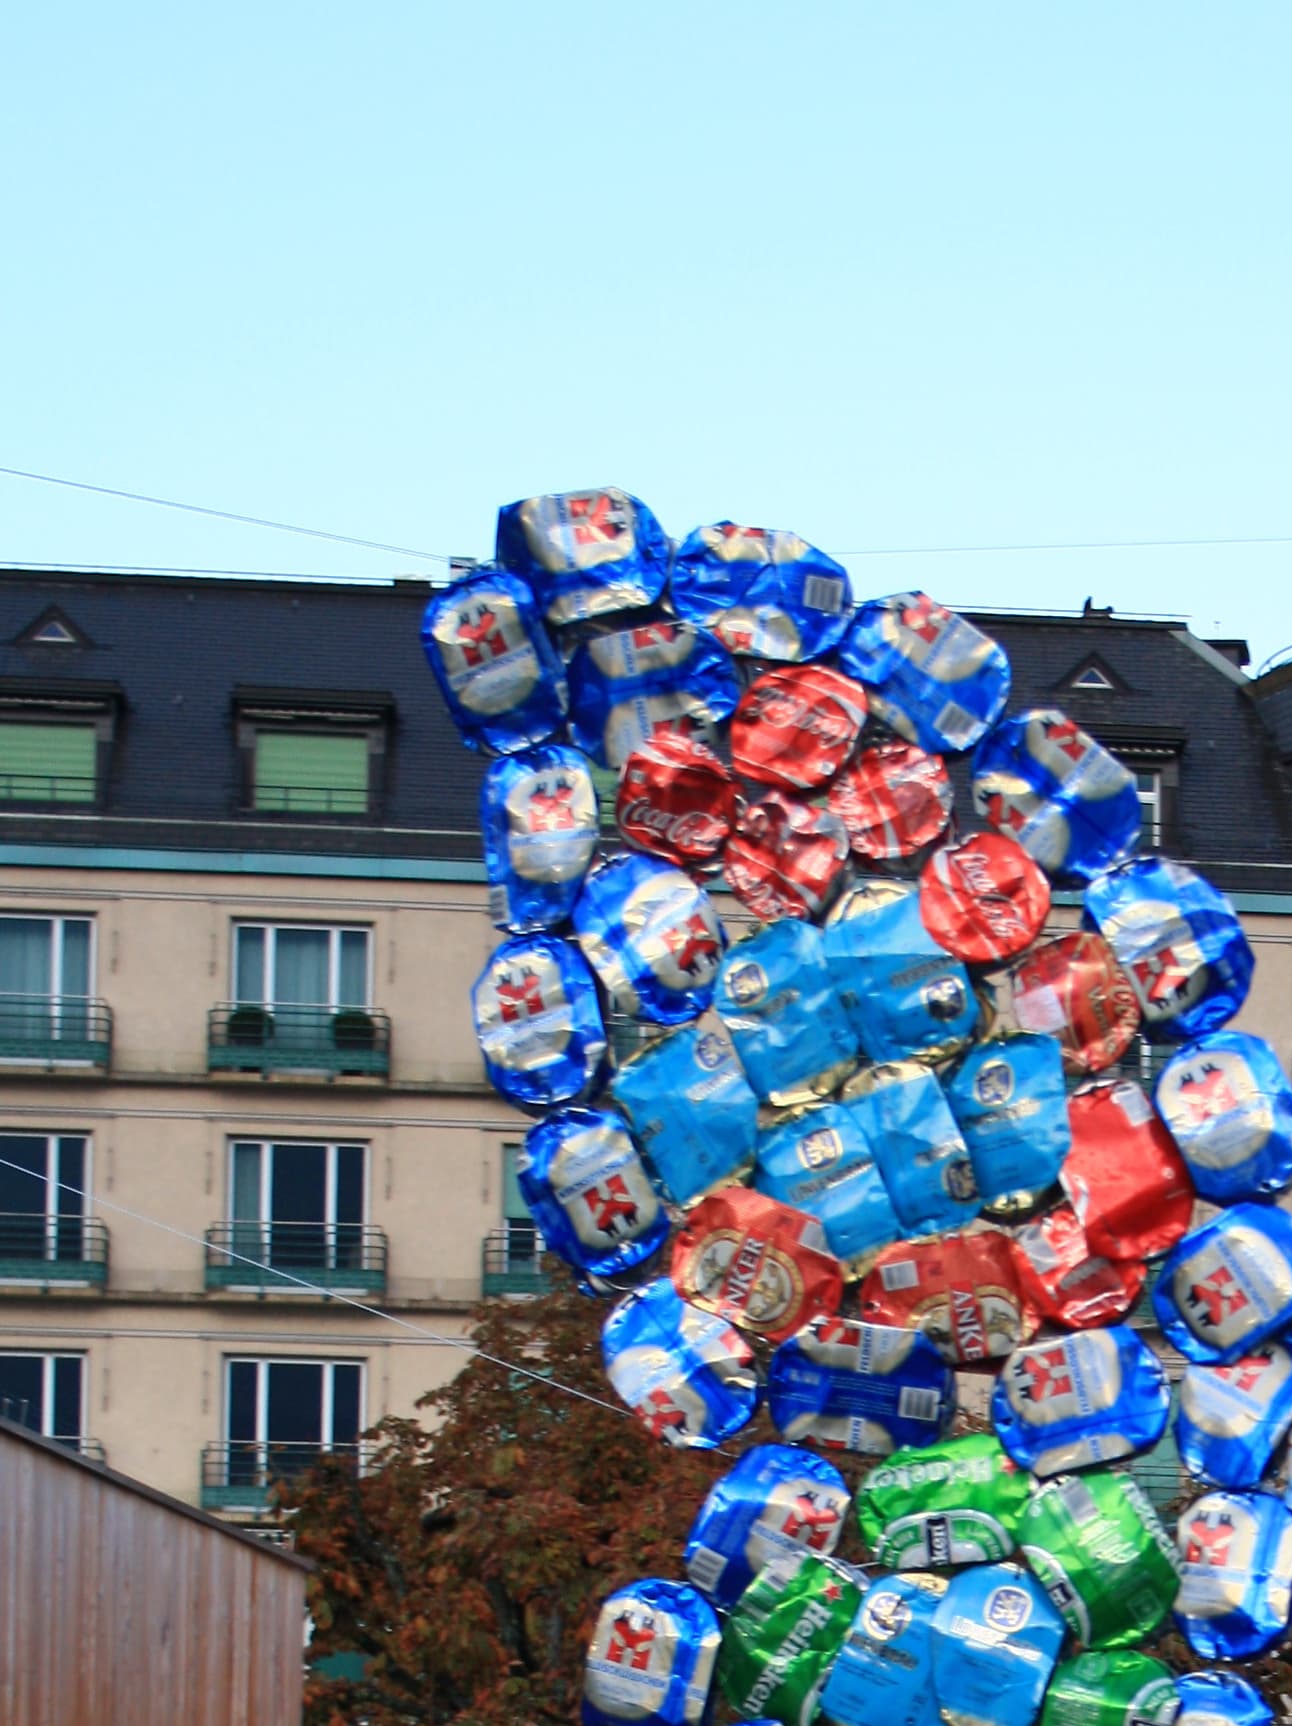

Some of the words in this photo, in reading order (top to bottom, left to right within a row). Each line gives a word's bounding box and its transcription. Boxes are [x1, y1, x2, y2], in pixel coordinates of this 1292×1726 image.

[618, 797, 729, 853] Coca-Cola
[951, 851, 1031, 942] Coca-Cola
[720, 1235, 765, 1322] ANKER
[949, 1288, 985, 1362] ANKE
[741, 1599, 832, 1714] Heineken
